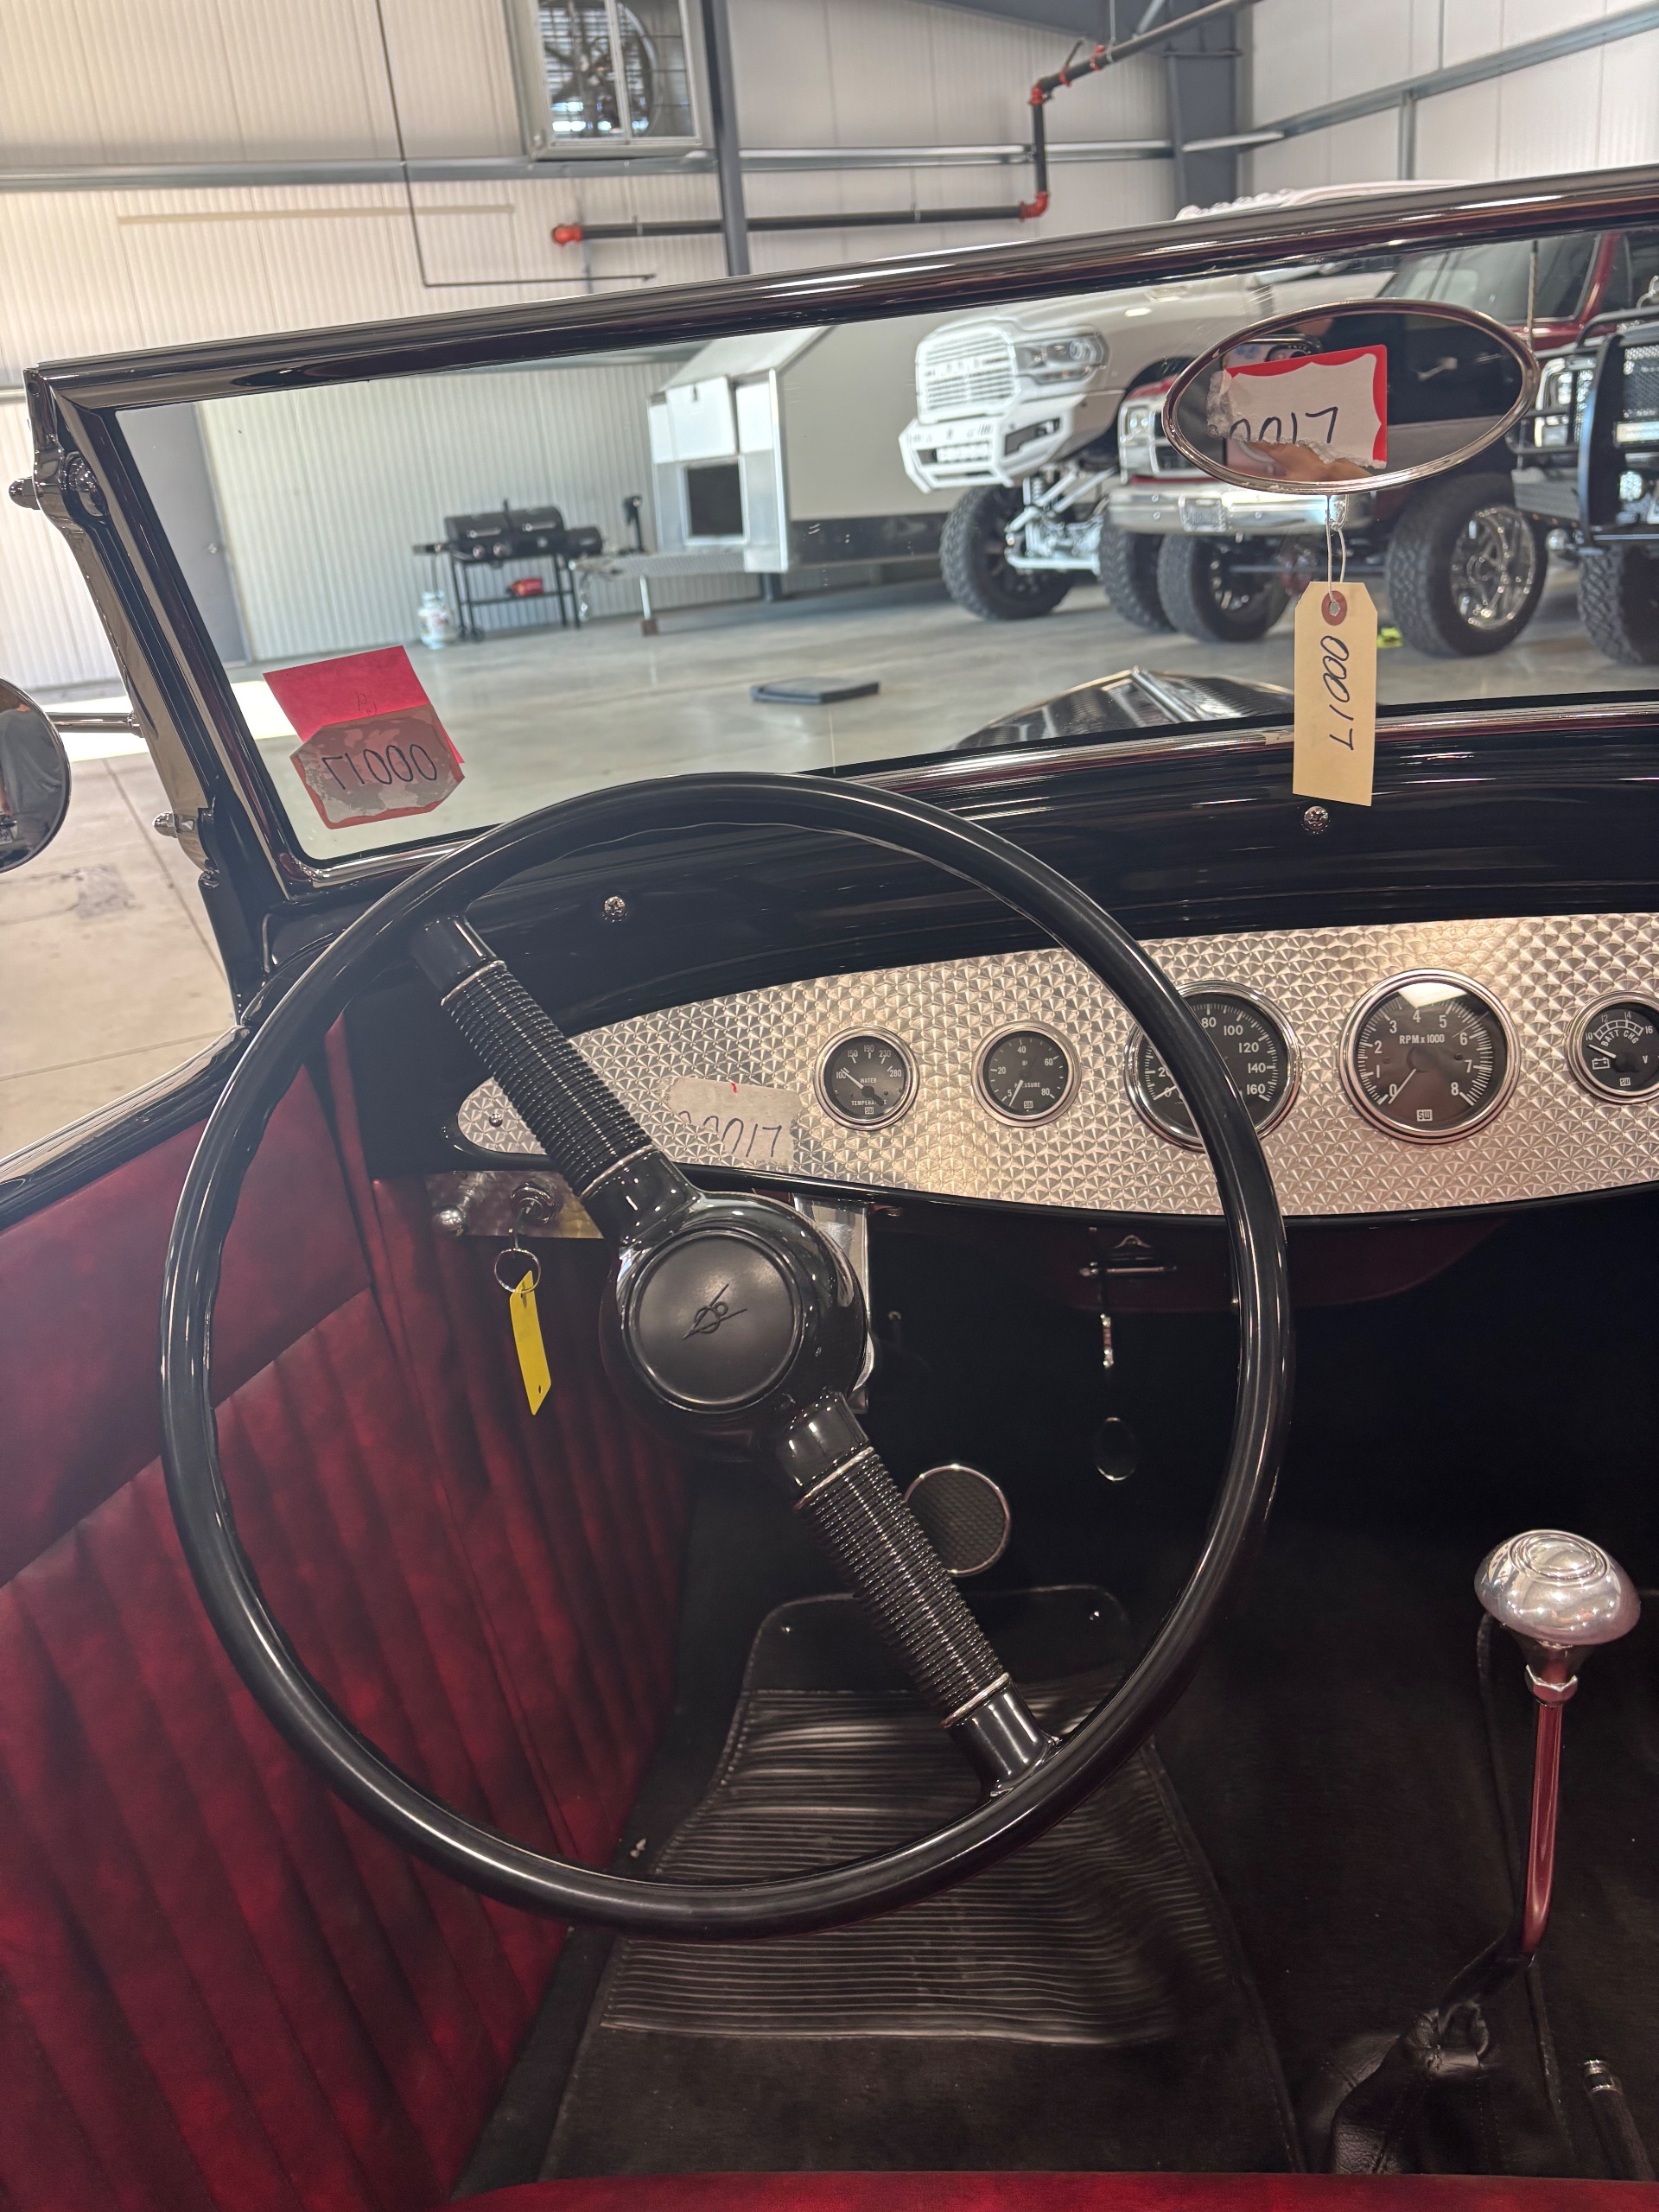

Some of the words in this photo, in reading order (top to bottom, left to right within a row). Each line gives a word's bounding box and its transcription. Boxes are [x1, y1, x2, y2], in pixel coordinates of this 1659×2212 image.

[1320, 635, 1354, 751] 00017
[1413, 1010, 1421, 1023] 4
[1439, 1014, 1447, 1028] 5
[1601, 1014, 1608, 1022] 12
[1624, 1011, 1631, 1020] 14
[1201, 1017, 1217, 1028] 80
[1389, 1020, 1397, 1034] 3
[1224, 1025, 1243, 1036] 100
[1645, 1026, 1653, 1034] 16
[1399, 1035, 1420, 1045] RPM
[1427, 1033, 1446, 1044] 1000
[1459, 1033, 1468, 1046] 6
[1586, 1033, 1592, 1041] 10
[1601, 1030, 1618, 1046] BATT
[1623, 1030, 1639, 1044] CHG
[1238, 1042, 1260, 1053] 120
[1375, 1040, 1382, 1054] 2
[1044, 1058, 1053, 1066] 60
[1643, 1055, 1648, 1064] V
[1248, 1063, 1267, 1073] 140
[1376, 1065, 1381, 1078] 1
[1464, 1059, 1472, 1073] 7
[836, 1071, 847, 1079] 100
[1247, 1084, 1266, 1095] 160
[1389, 1084, 1397, 1097] 0
[1451, 1082, 1459, 1096] 8
